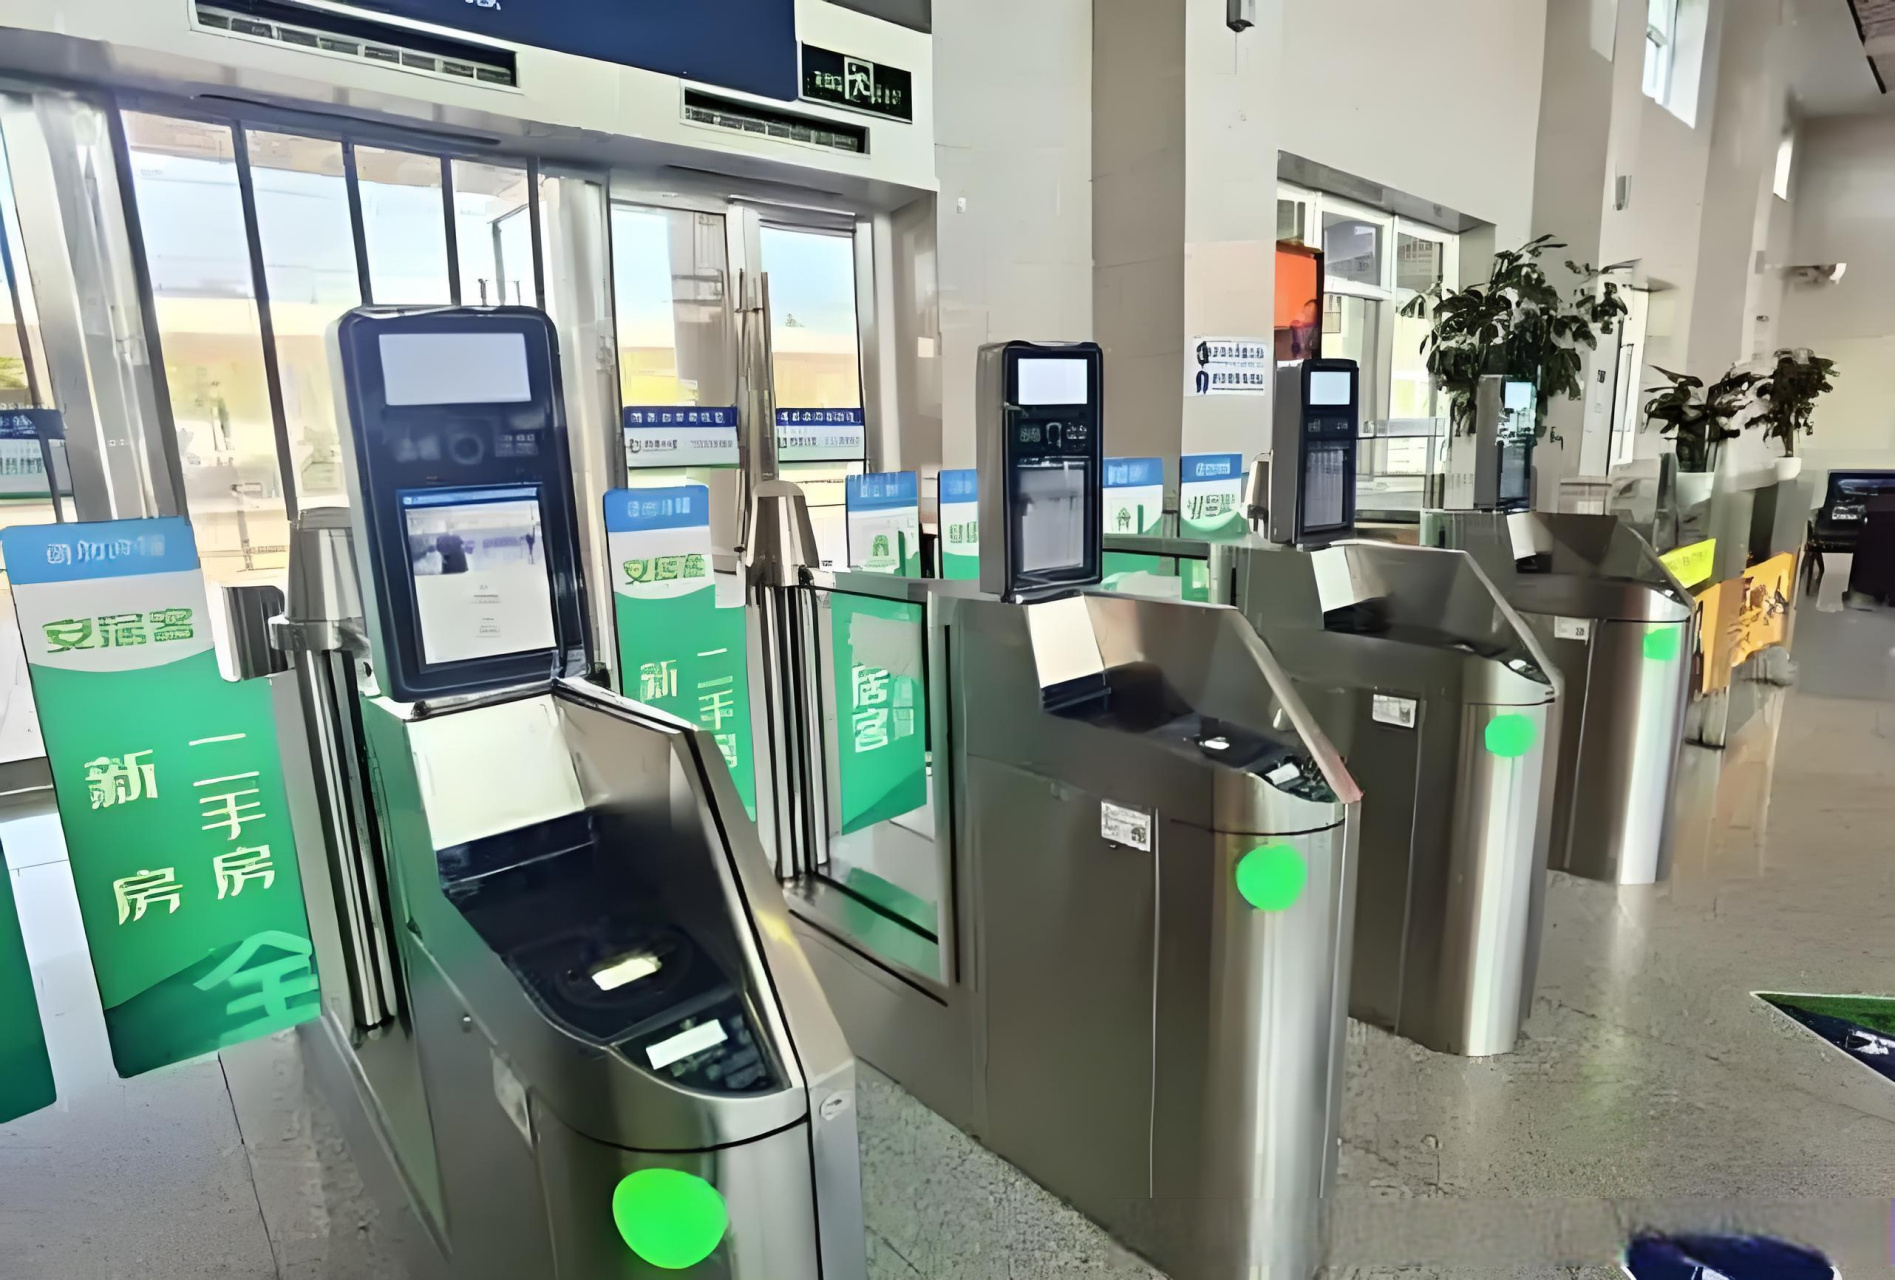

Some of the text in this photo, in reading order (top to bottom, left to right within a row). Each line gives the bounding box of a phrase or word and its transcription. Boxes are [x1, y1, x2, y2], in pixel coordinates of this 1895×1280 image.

[84, 749, 183, 926] 新房
[189, 733, 275, 900] 二手房
